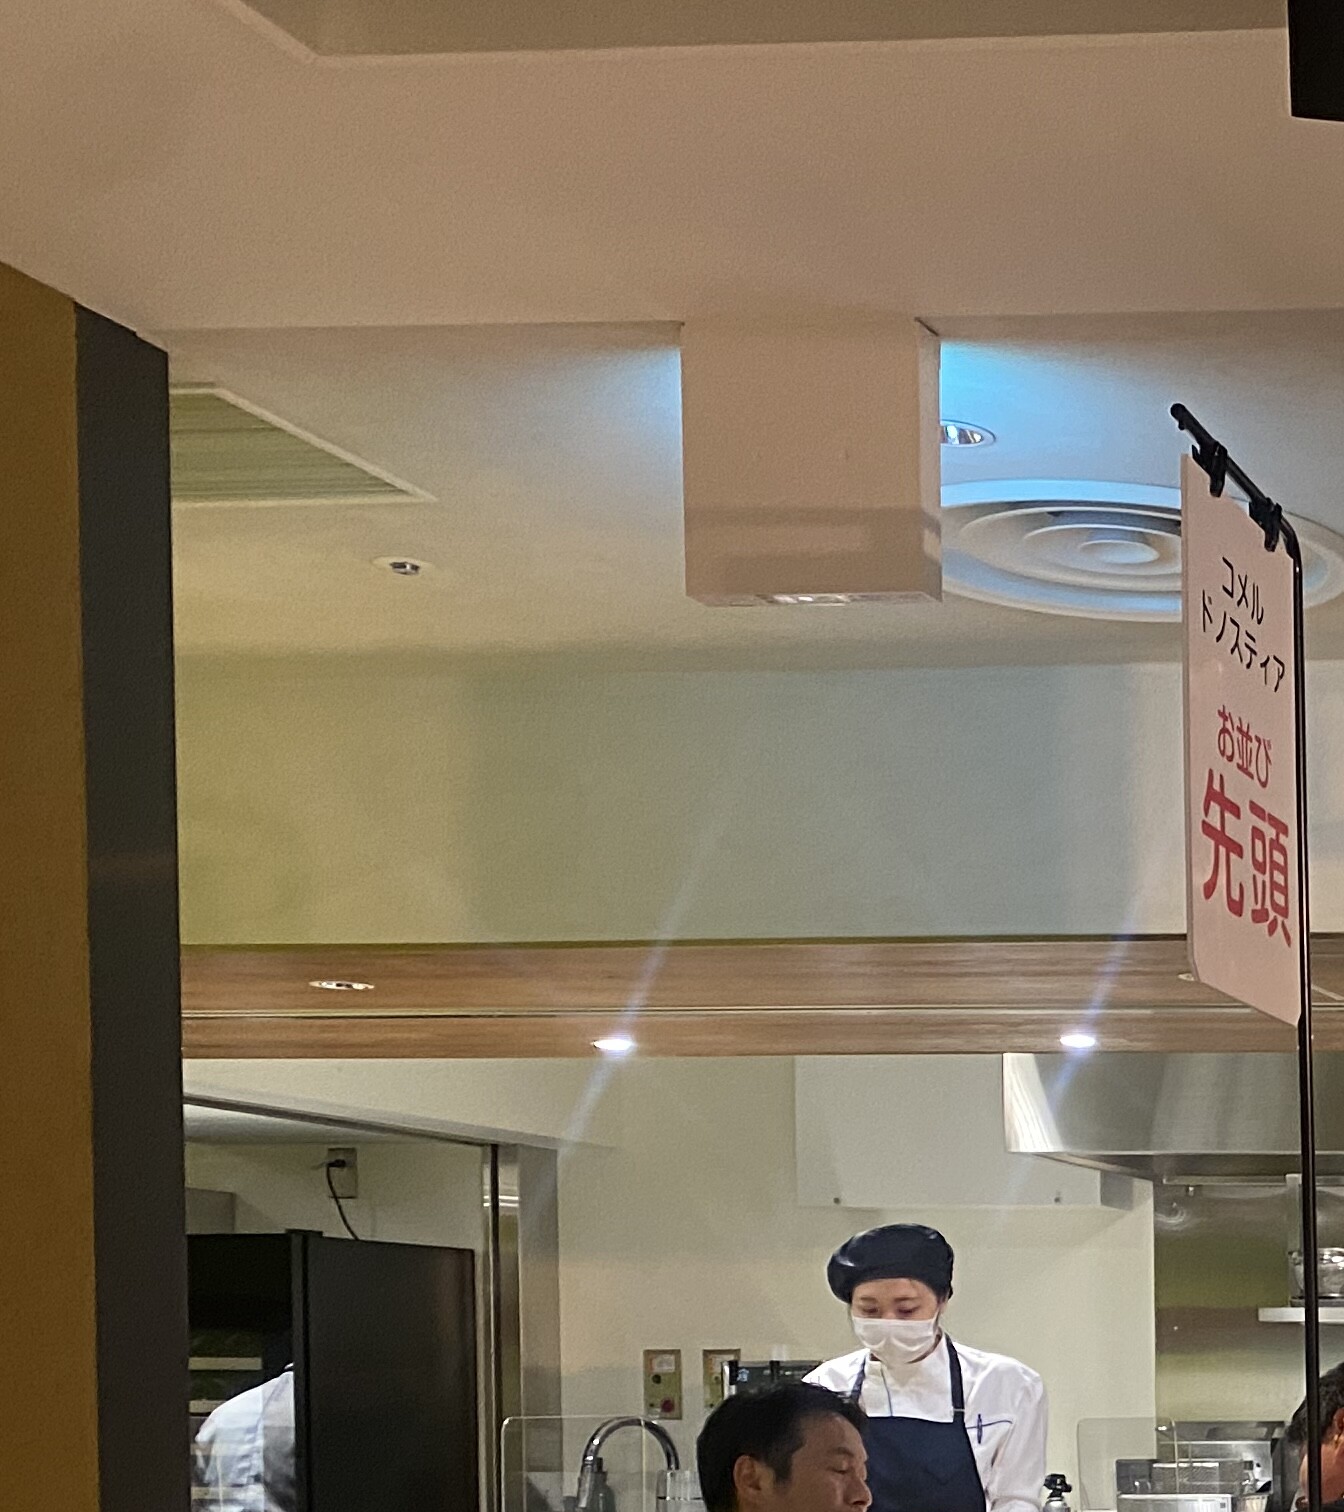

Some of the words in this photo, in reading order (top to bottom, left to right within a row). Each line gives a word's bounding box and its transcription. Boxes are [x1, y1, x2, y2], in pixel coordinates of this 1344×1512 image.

[1221, 556, 1265, 626] コメル
[1202, 588, 1286, 693] ドノスティア
[1217, 704, 1273, 790] お並び
[1201, 766, 1292, 948] 先頭
